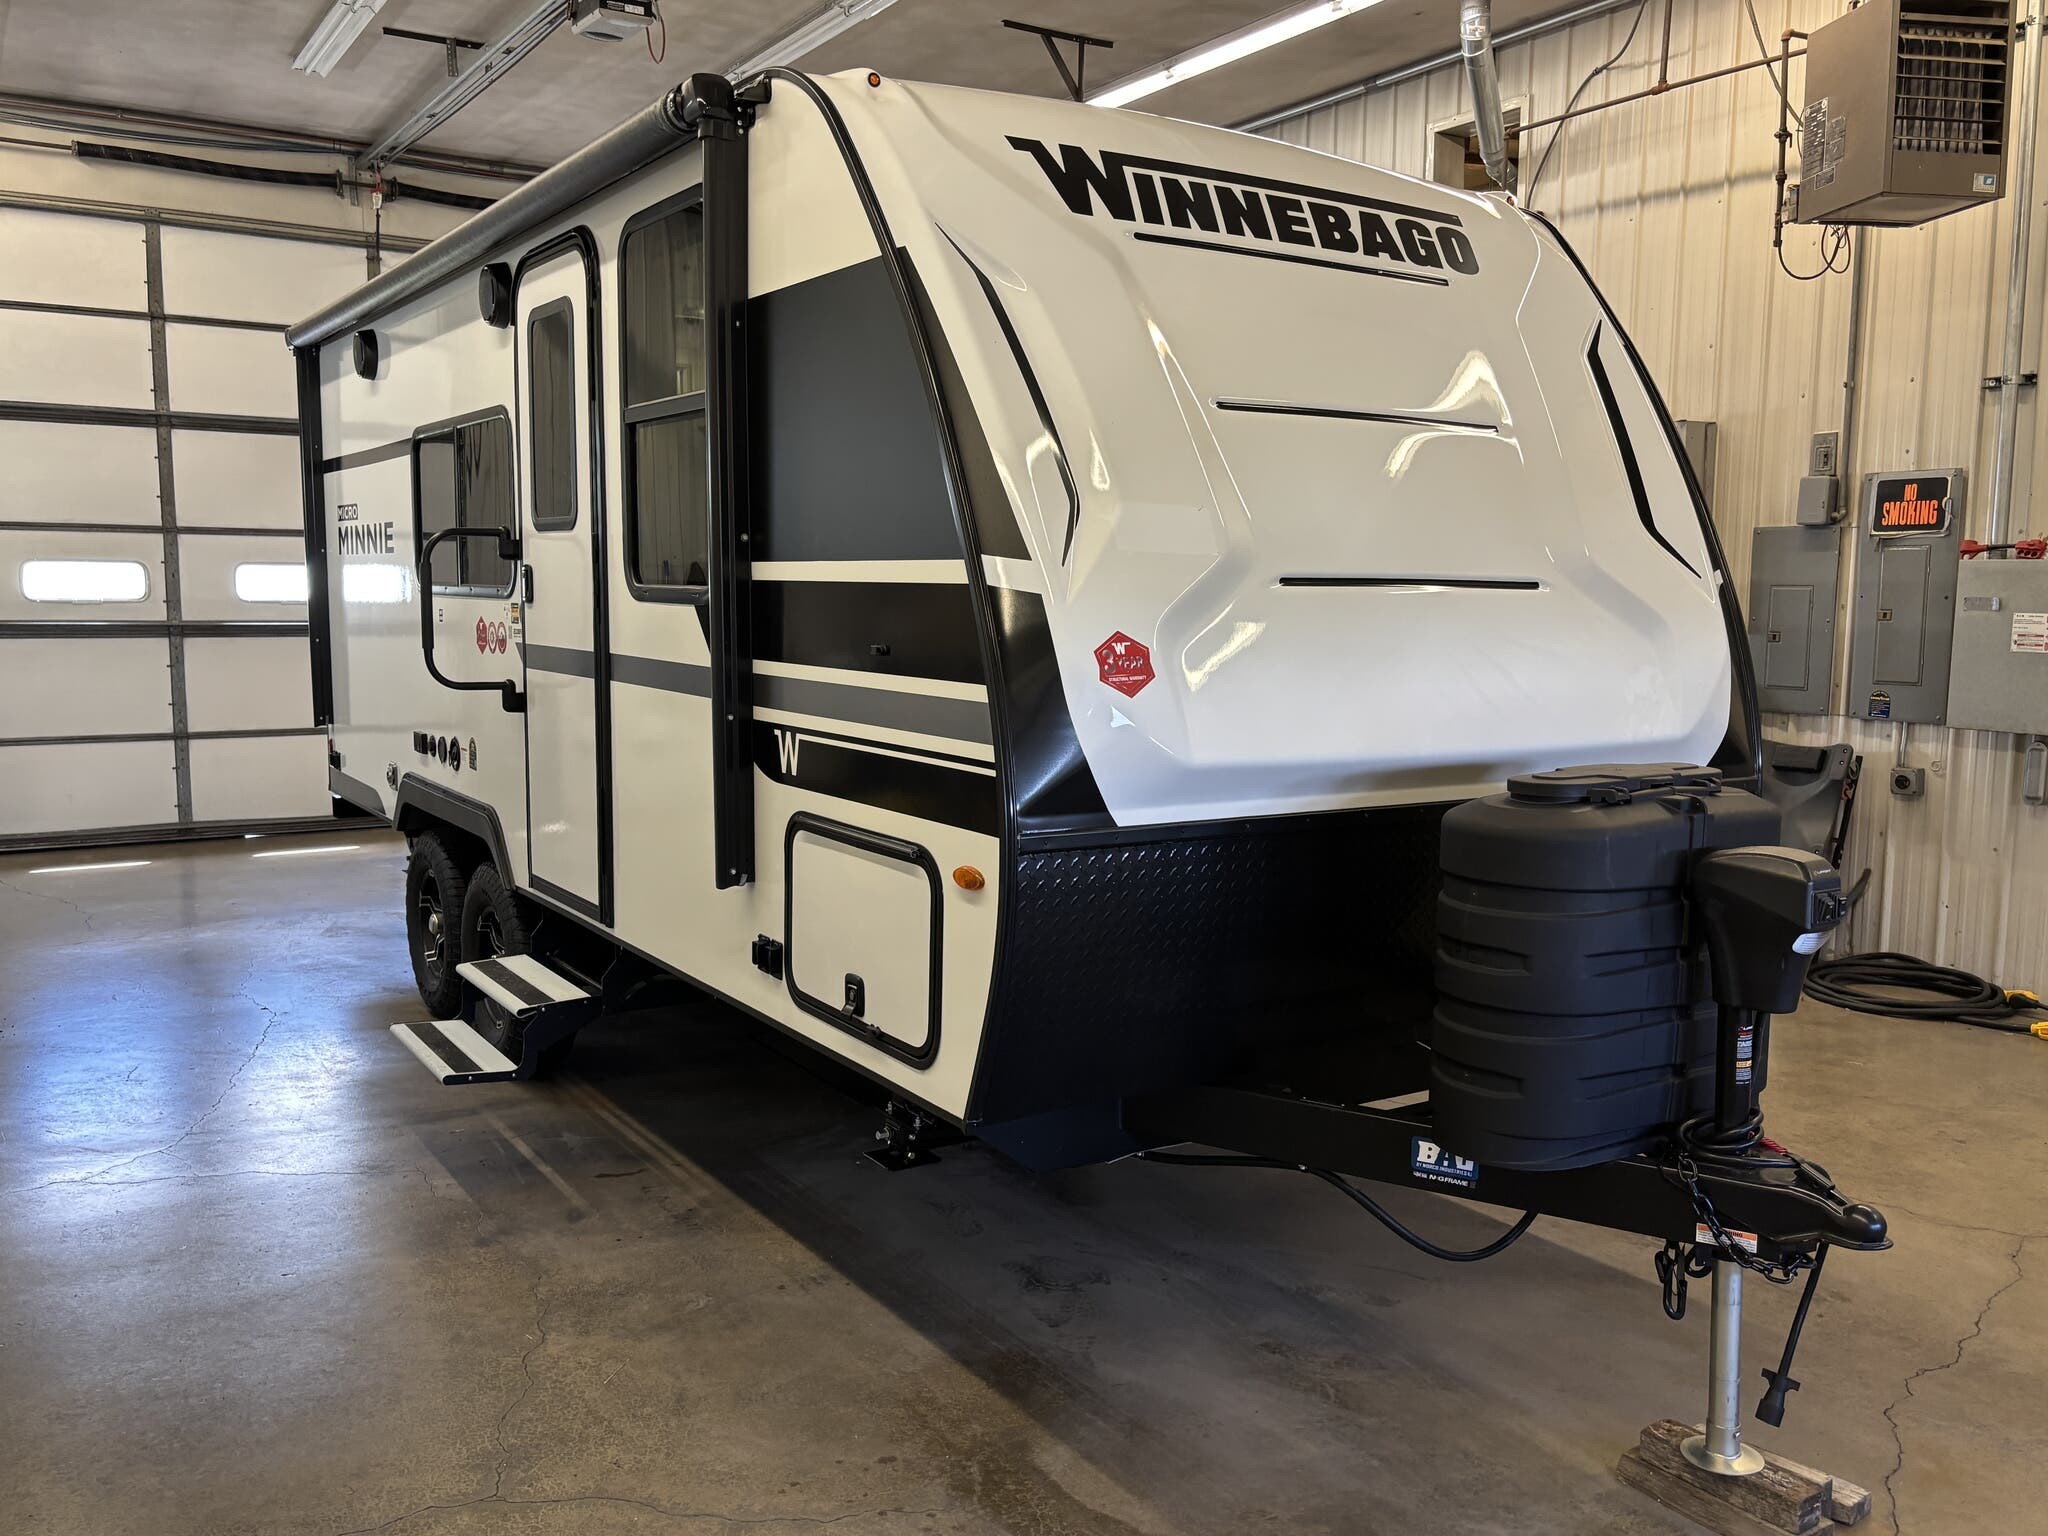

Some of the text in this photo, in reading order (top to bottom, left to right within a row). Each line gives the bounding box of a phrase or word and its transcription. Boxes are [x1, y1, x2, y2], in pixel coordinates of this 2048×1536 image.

[1004, 135, 1480, 275] WINNEBAGO
[1903, 483, 1918, 501] NO
[337, 505, 358, 520] MICRO
[1881, 499, 1938, 526] SMOKING
[338, 521, 395, 556] MINNIE
[1102, 649, 1116, 674] 3
[774, 729, 800, 777] W
